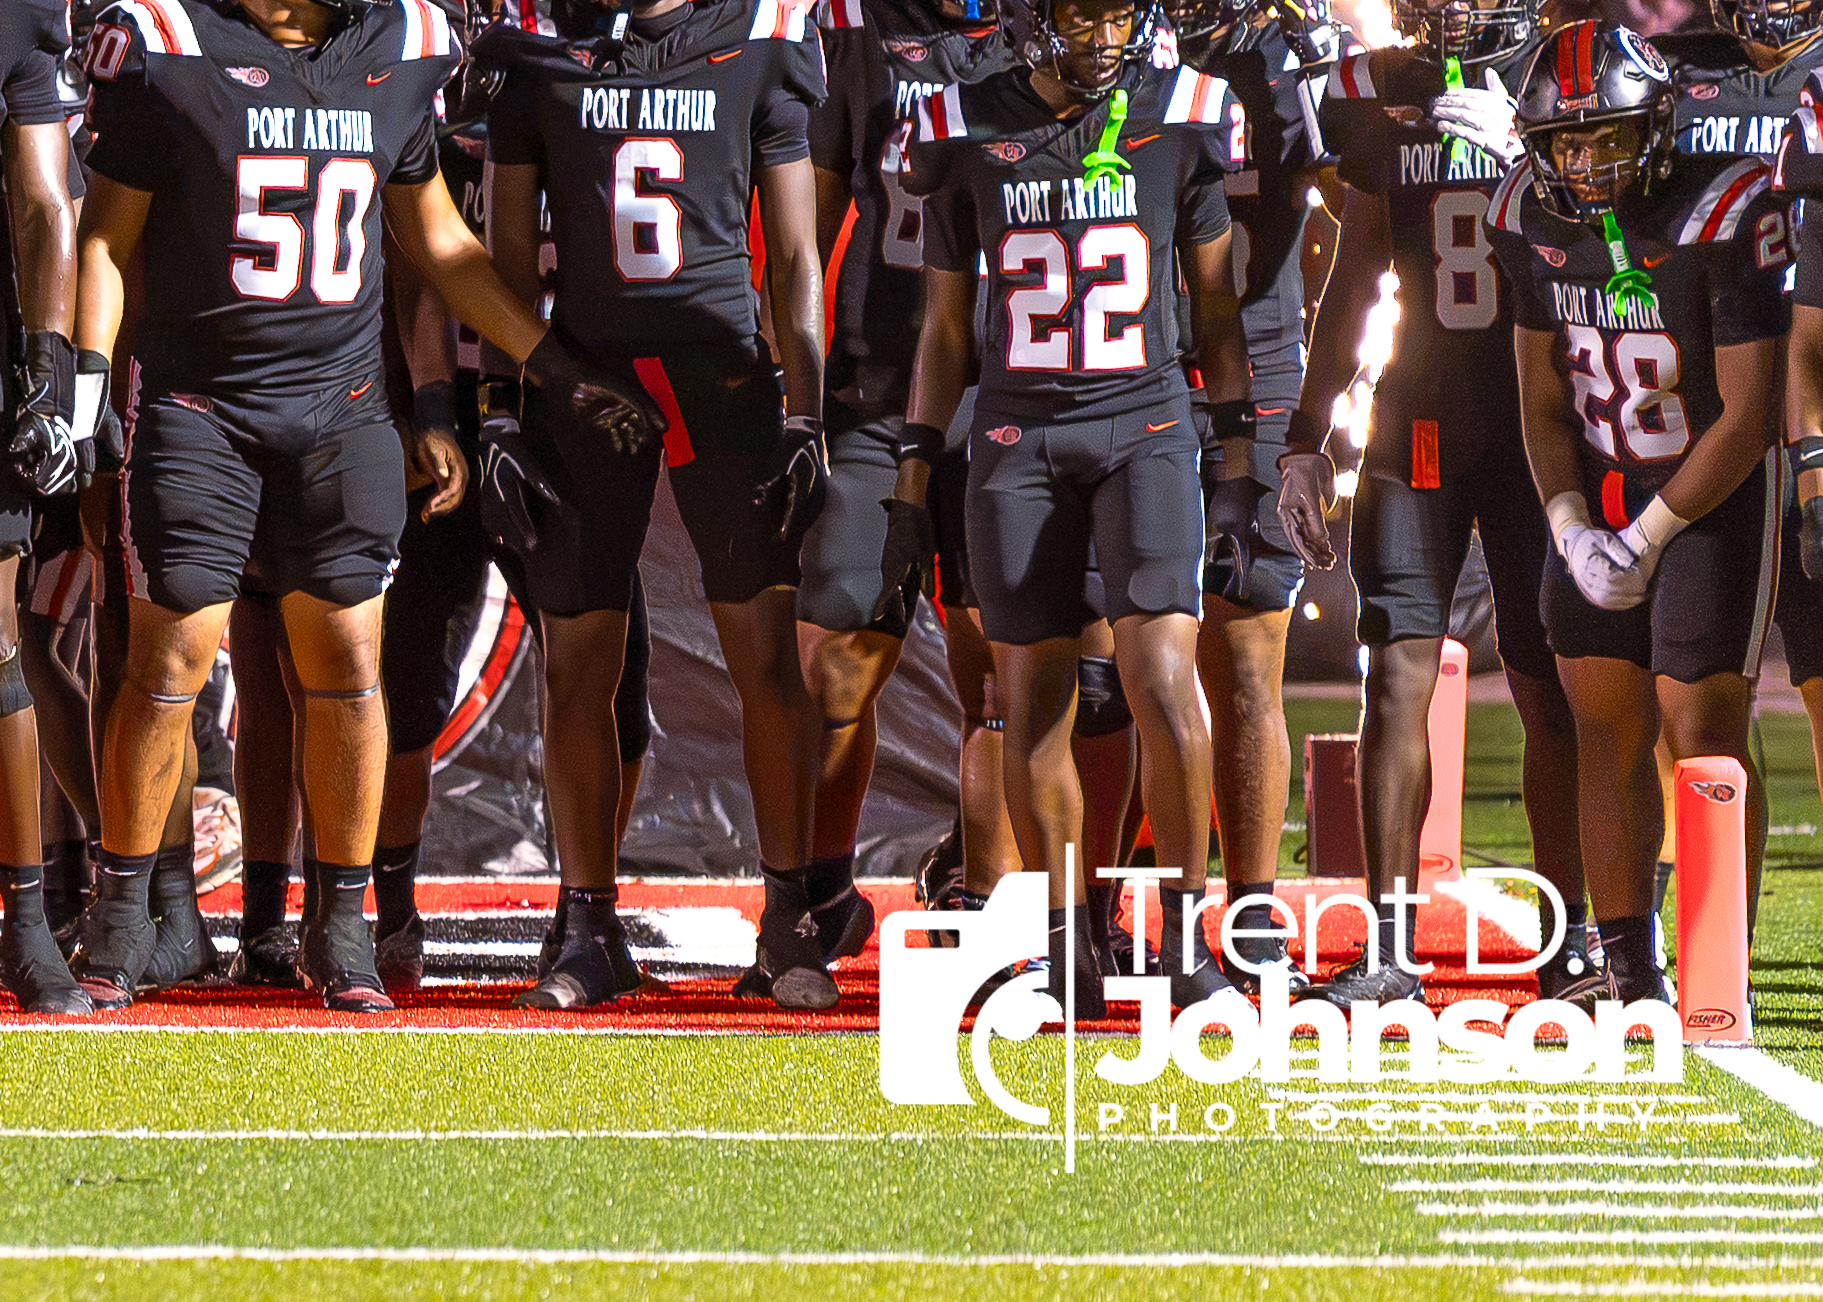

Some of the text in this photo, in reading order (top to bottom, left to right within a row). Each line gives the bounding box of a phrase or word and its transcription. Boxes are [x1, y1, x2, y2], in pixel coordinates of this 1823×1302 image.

[247, 107, 375, 153] PORT ARTHUR
[581, 87, 718, 132] PORT ARTHUR
[1691, 116, 1740, 154] PORT
[1400, 142, 1442, 186] PORT
[611, 136, 685, 283] 6
[1002, 180, 1051, 225] PORT
[229, 155, 378, 306] 50
[1432, 188, 1499, 330] 8
[998, 223, 1151, 372] 22
[1552, 281, 1588, 326] PORT
[1565, 322, 1691, 462] 28
[1688, 1012, 1727, 1026] FISHER
